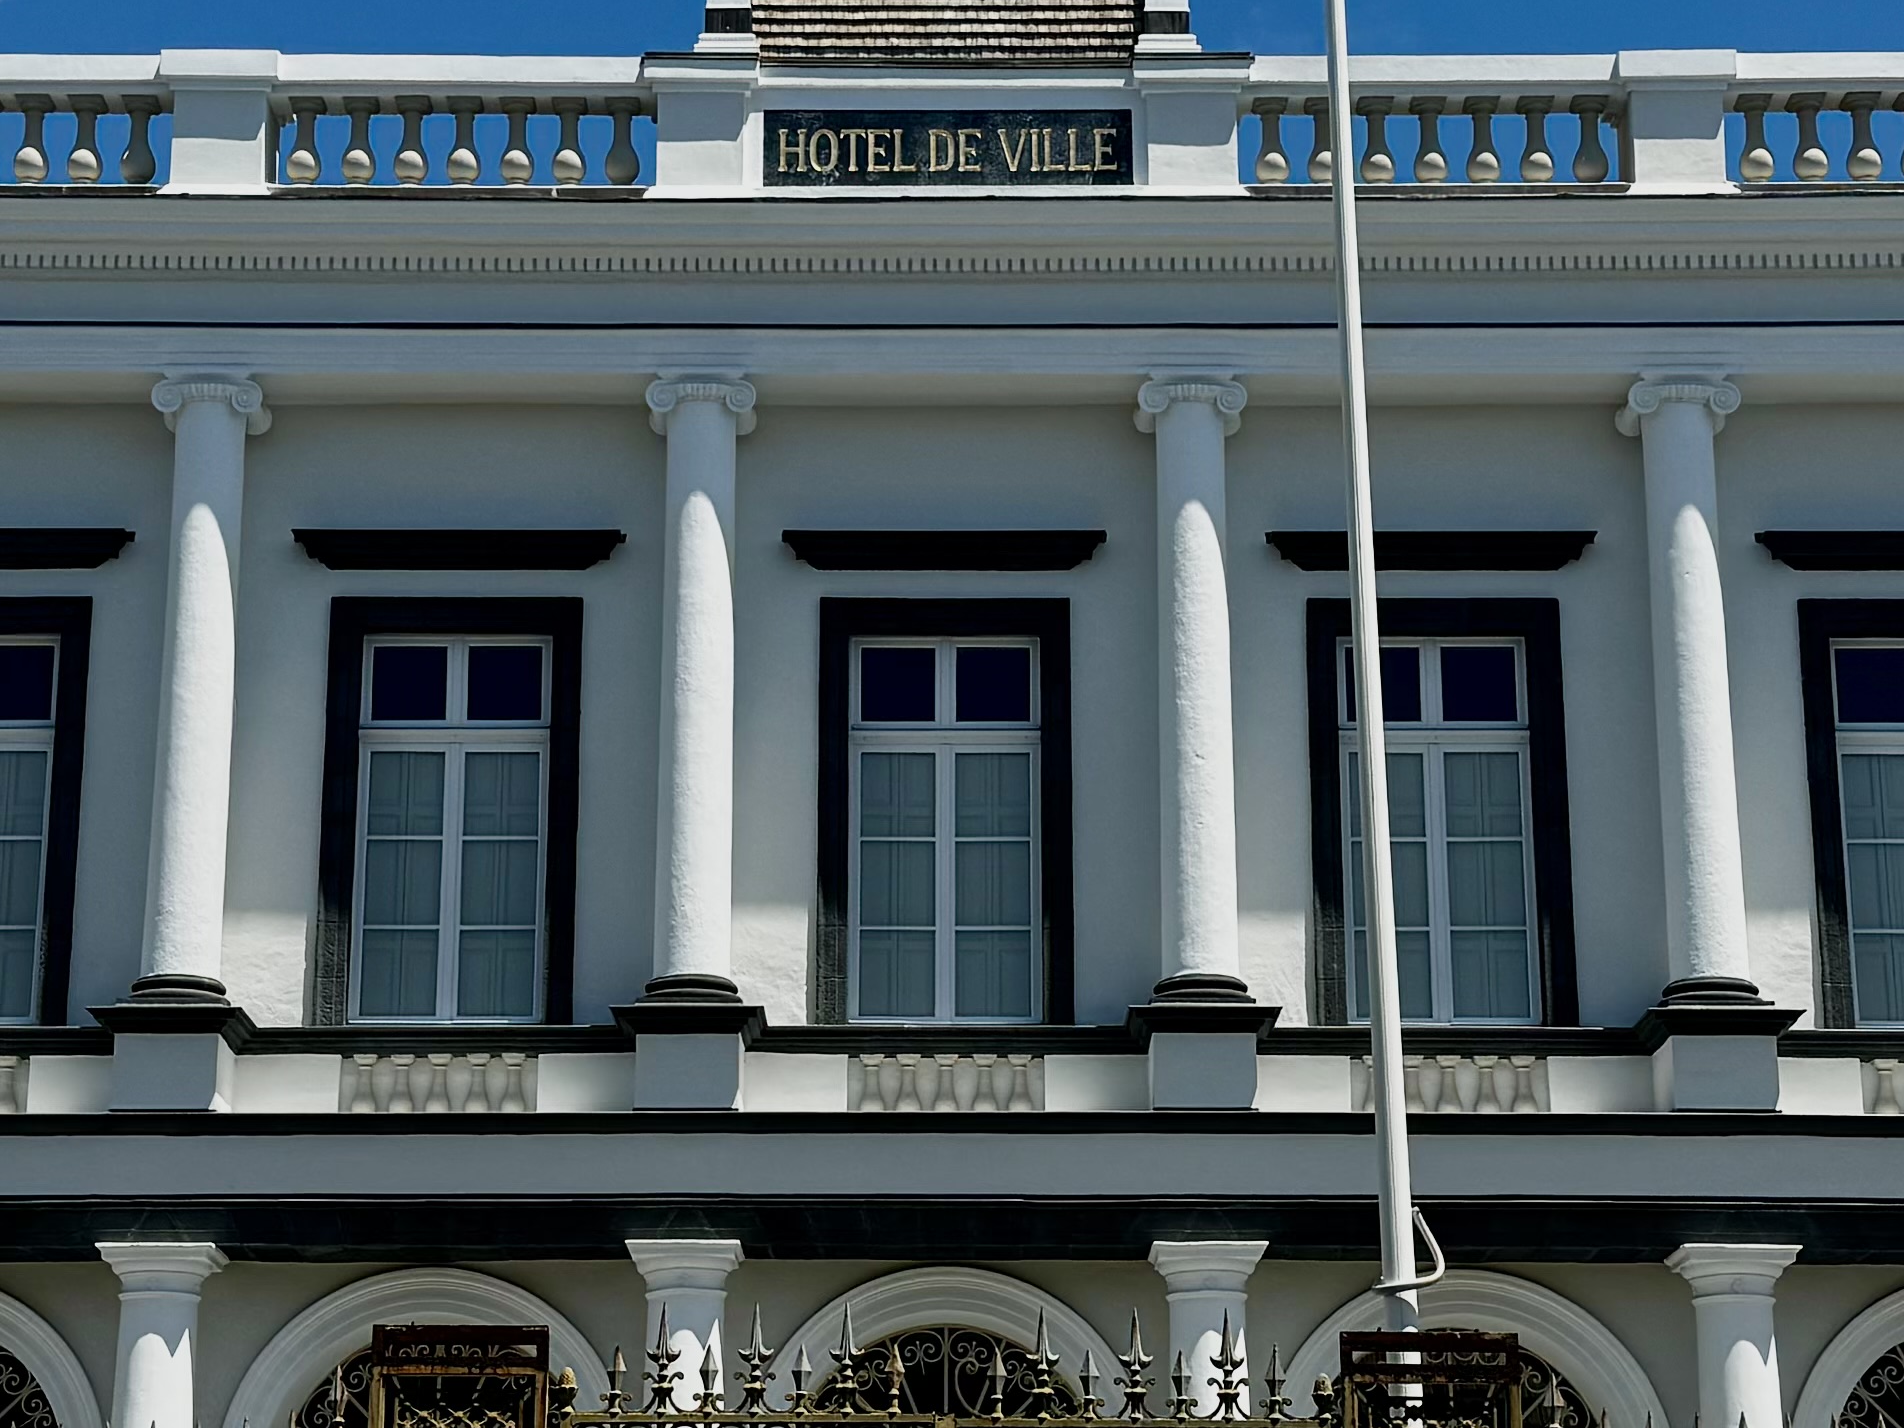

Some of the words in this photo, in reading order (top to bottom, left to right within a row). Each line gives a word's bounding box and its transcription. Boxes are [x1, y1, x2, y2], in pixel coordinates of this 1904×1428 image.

[777, 128, 918, 172] HOTEL
[929, 128, 983, 172] DE
[997, 128, 1118, 172] VILLE
